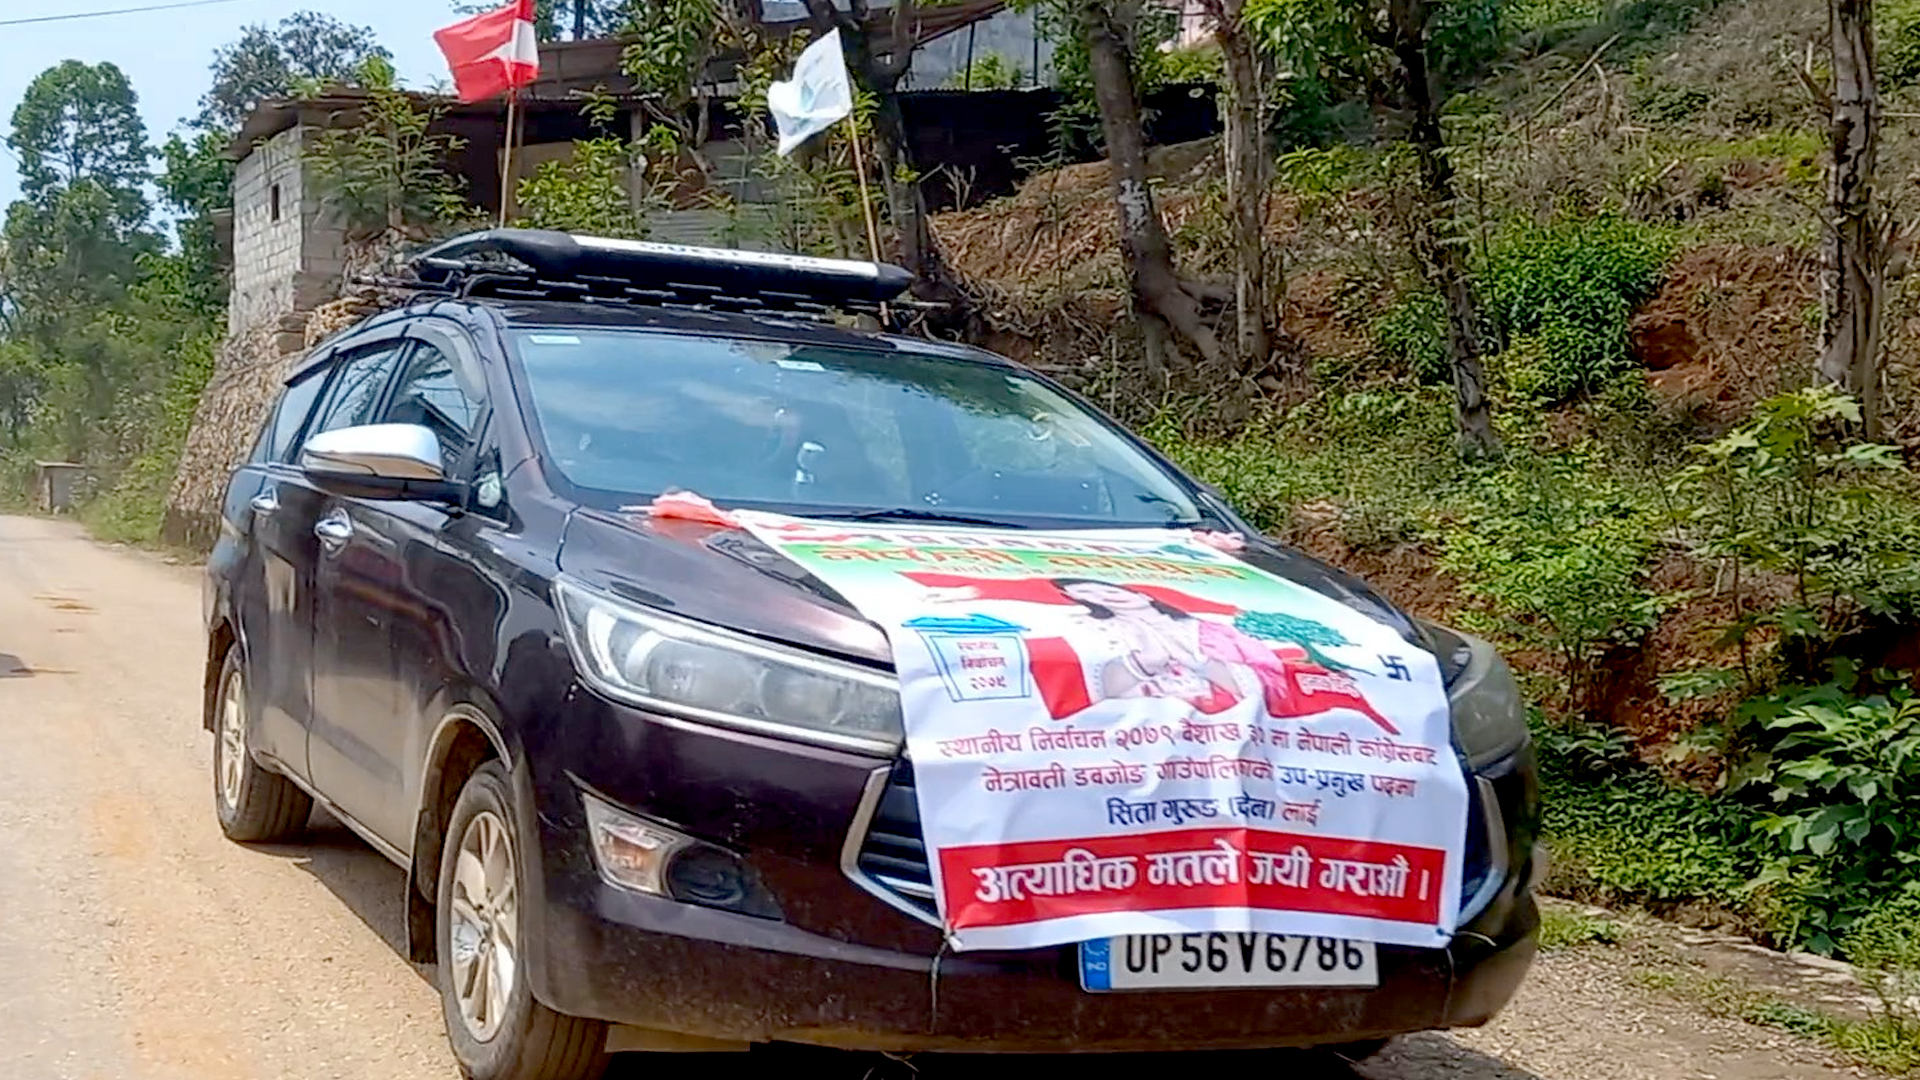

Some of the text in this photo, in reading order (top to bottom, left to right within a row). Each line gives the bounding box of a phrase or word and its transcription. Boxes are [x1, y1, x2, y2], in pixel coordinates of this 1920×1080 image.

[937, 729, 1021, 757] स्थानीय
[1030, 725, 1106, 751] निर्वाचन
[1116, 725, 1176, 751] २०७९
[1297, 726, 1352, 756] नेपाली
[982, 762, 1066, 791] नेत्रावती
[1279, 765, 1365, 797] उप-प्रमुख
[1106, 797, 1157, 825] सिता
[1282, 799, 1322, 827] लाई
[971, 848, 1139, 903] अत्याधिक
[1145, 838, 1242, 886] मतले
[1247, 845, 1313, 889] जयी
